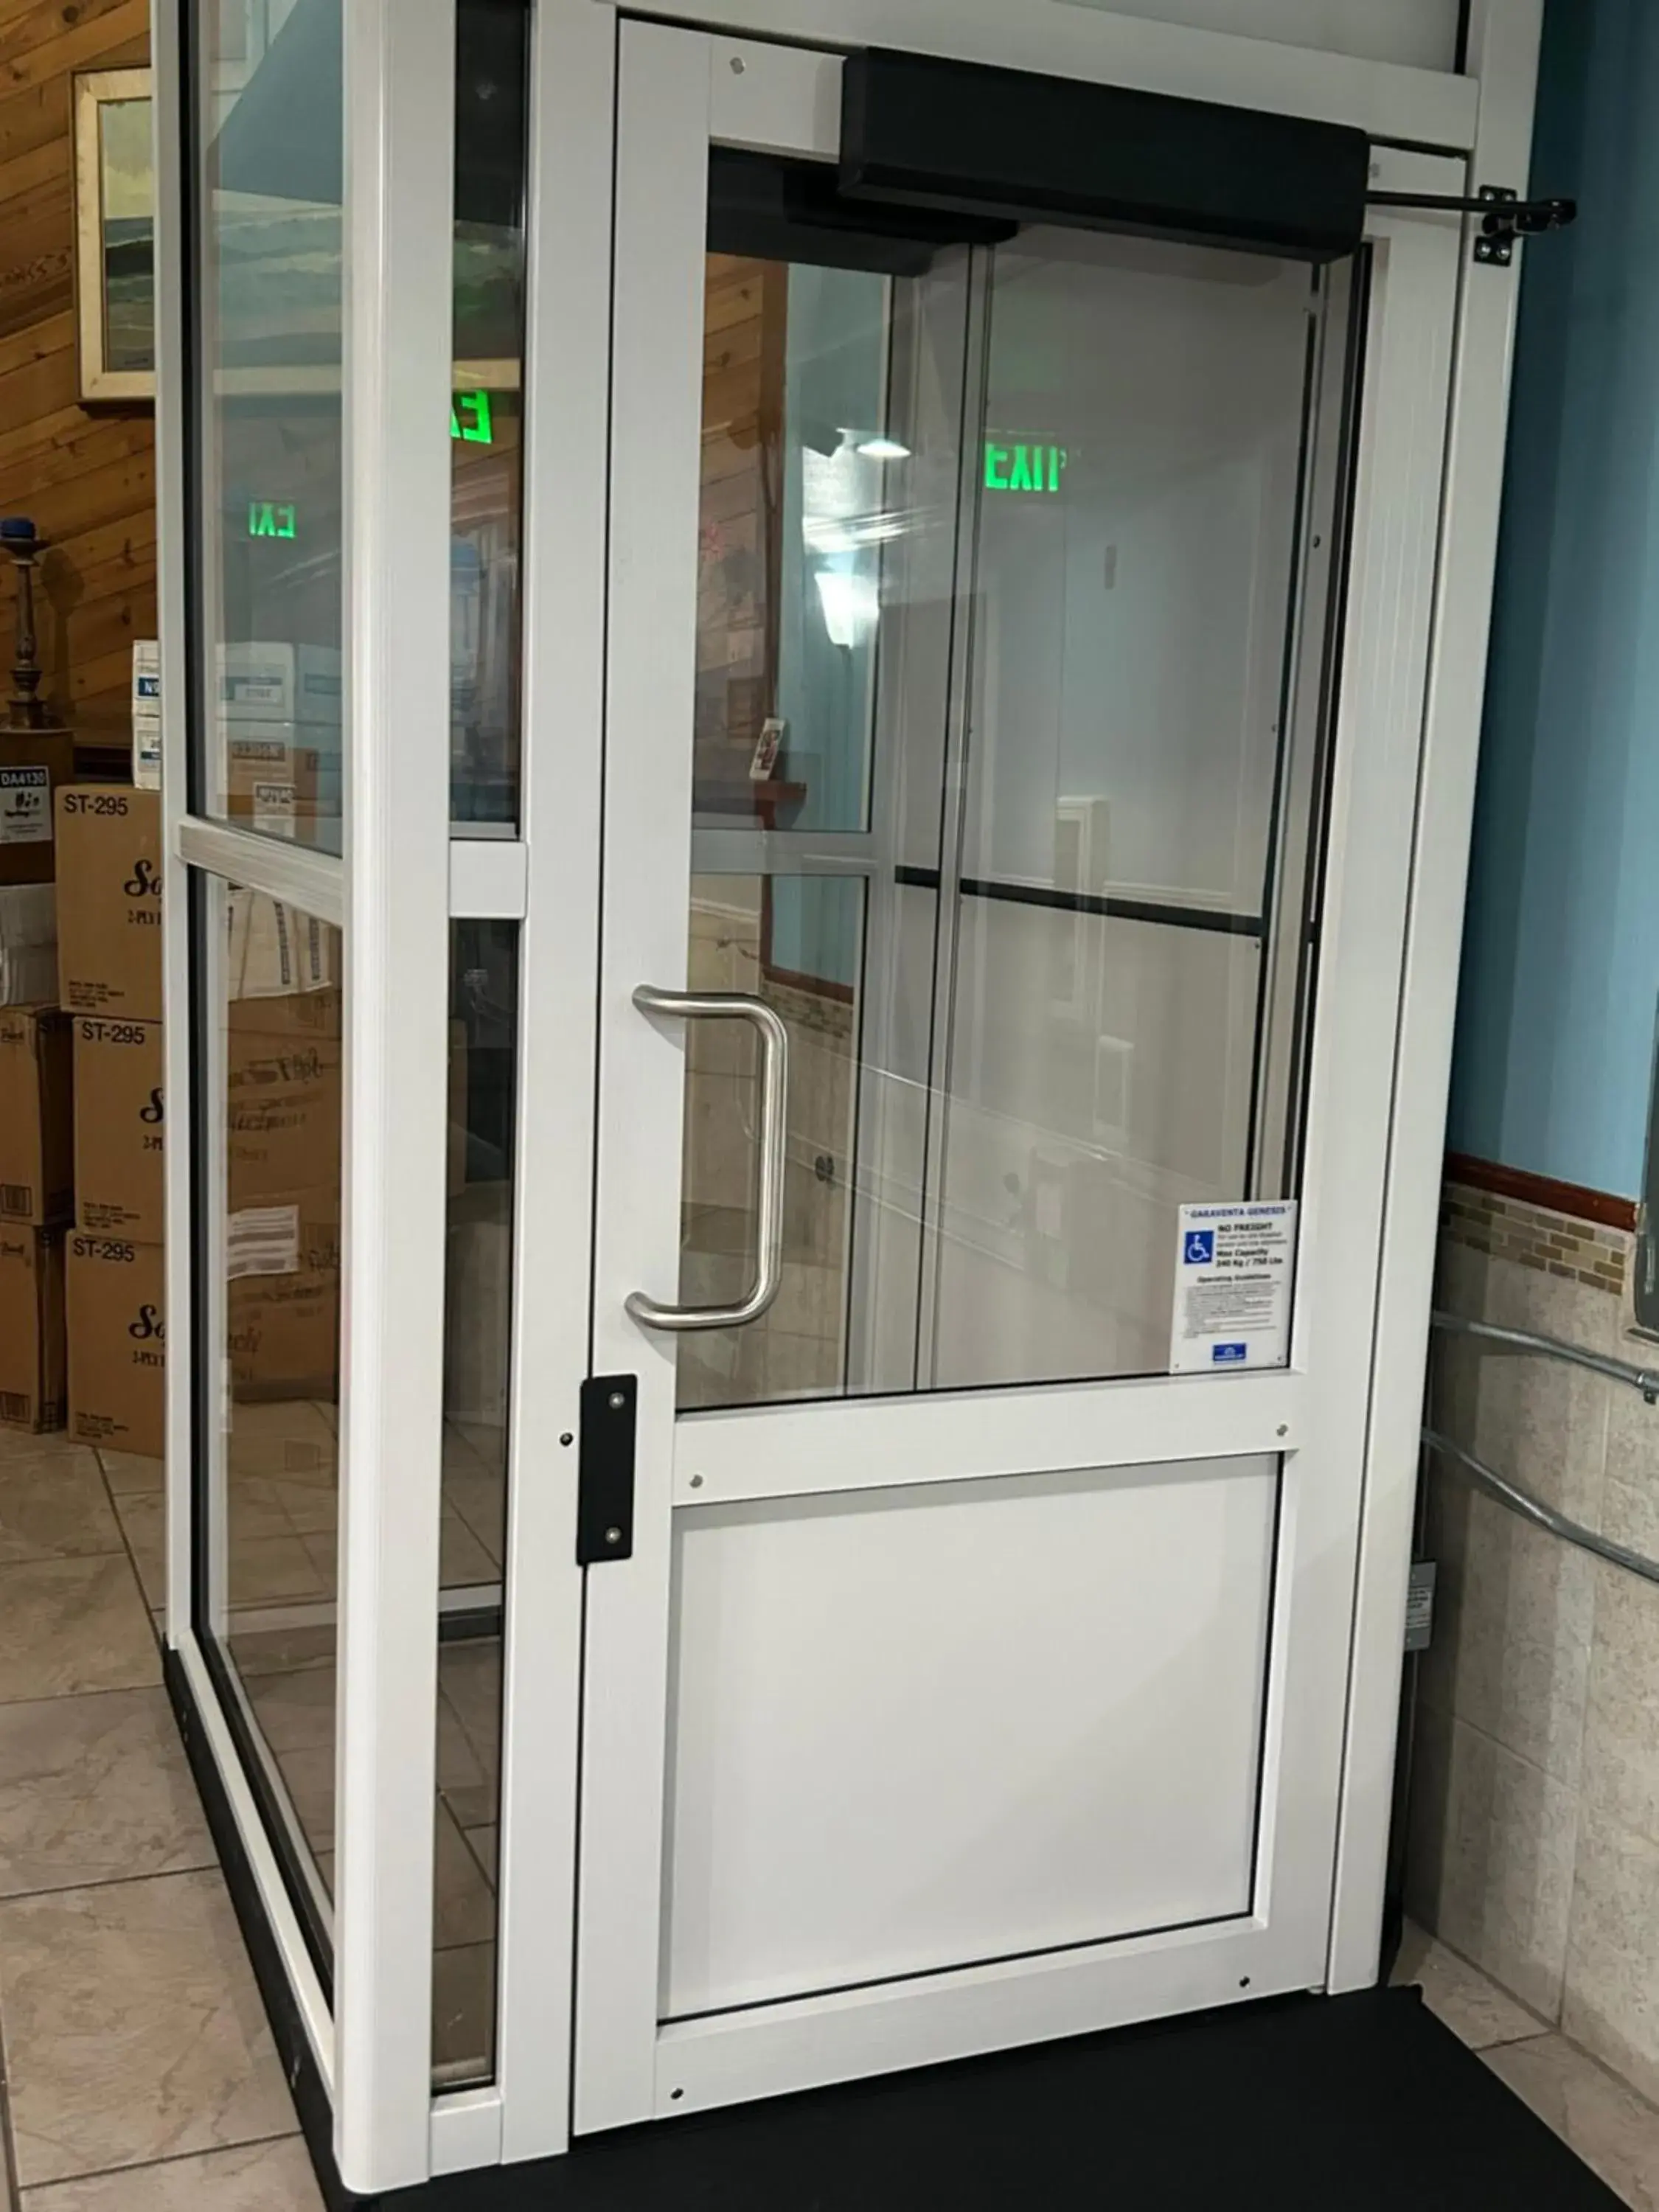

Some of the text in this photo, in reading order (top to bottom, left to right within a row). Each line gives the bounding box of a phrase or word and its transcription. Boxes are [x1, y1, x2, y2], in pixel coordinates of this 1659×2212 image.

[63, 793, 128, 816] ST-295
[82, 1021, 145, 1045] ST-295
[1218, 1221, 1273, 1232] NO FREIGHT
[73, 1237, 135, 1263] ST-295
[1234, 1248, 1269, 1257] Capacity
